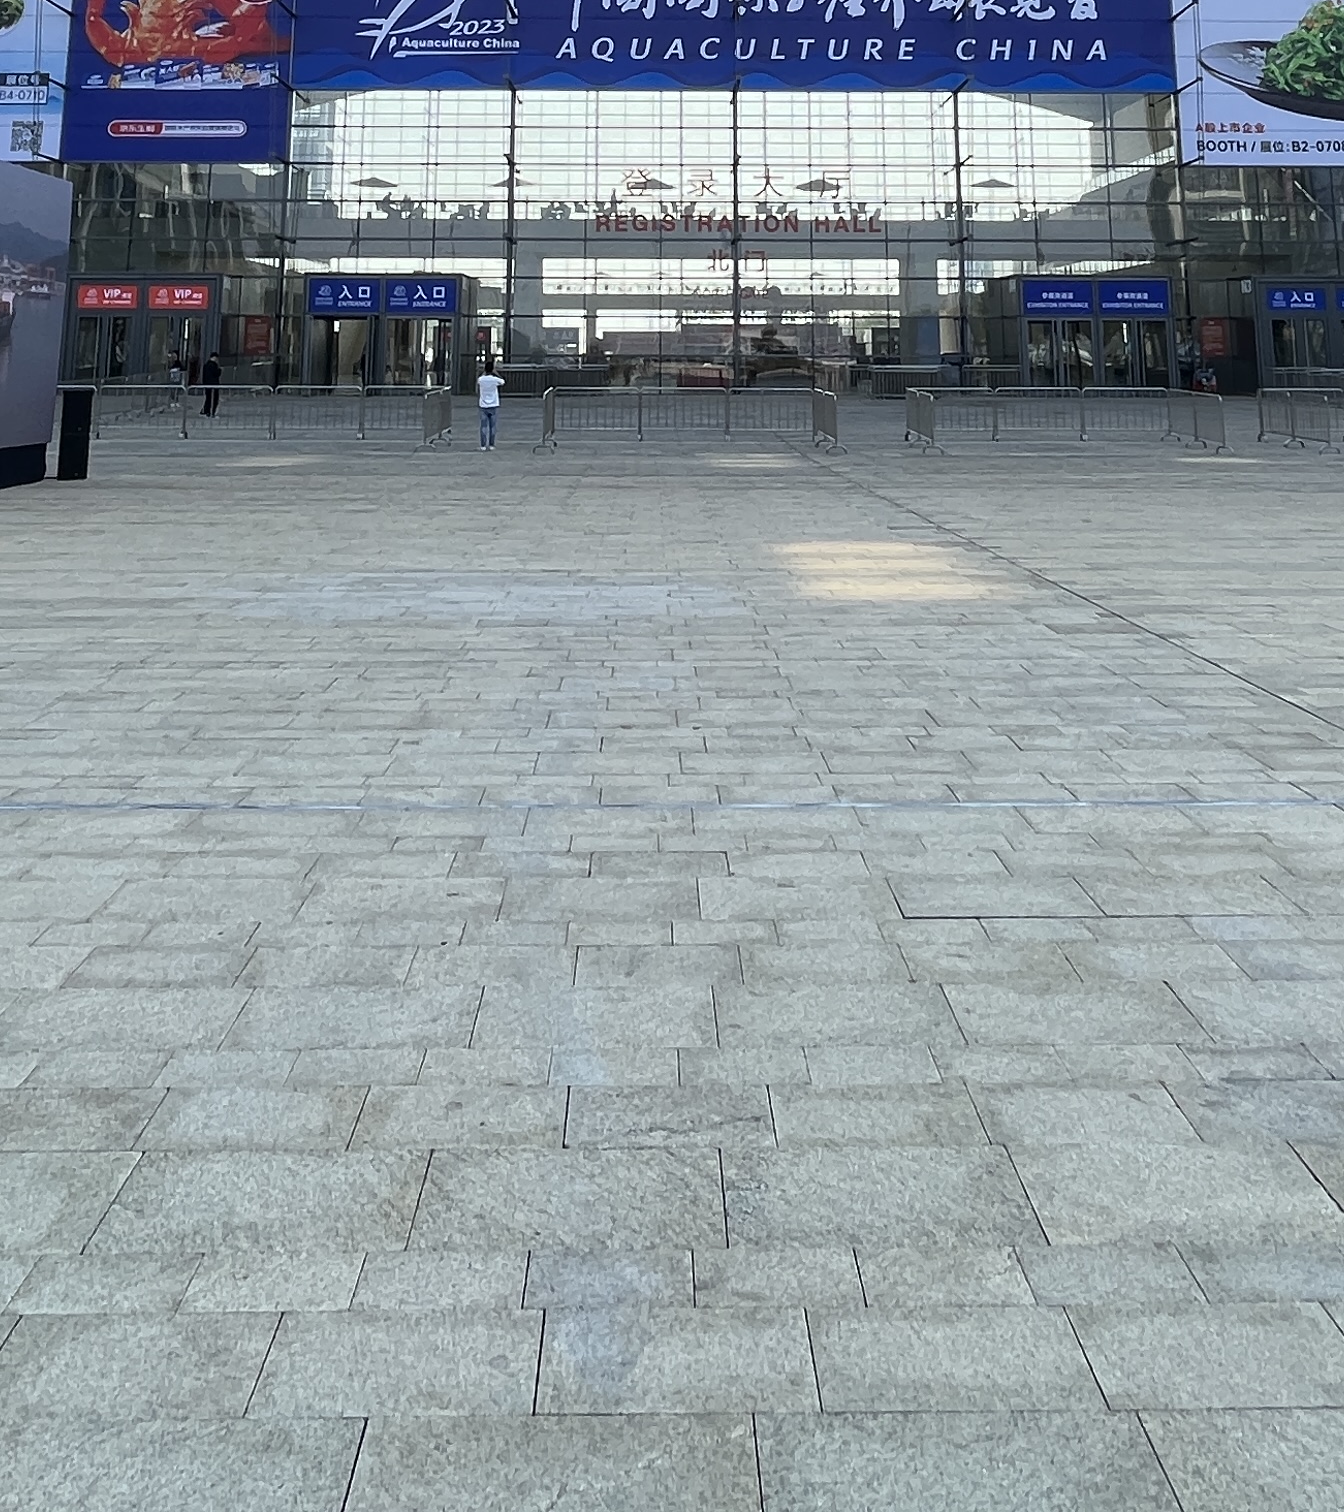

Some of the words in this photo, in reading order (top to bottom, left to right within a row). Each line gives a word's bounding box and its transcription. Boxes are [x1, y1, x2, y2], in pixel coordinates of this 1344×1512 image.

[449, 19, 506, 36] 2023
[402, 37, 480, 49] Aquaculture
[483, 37, 520, 49] China
[556, 37, 916, 63] AQUACULTURE
[955, 38, 1108, 61] CHINA
[1197, 140, 1247, 152] BOOTH
[595, 215, 799, 233] REGISTRATION
[814, 216, 882, 233] HALL
[708, 248, 766, 272] 北门
[103, 288, 122, 299] VIP
[174, 289, 192, 299] VIP
[338, 284, 371, 299] 入口
[413, 284, 446, 300] 入口
[1290, 291, 1315, 302] 入口
